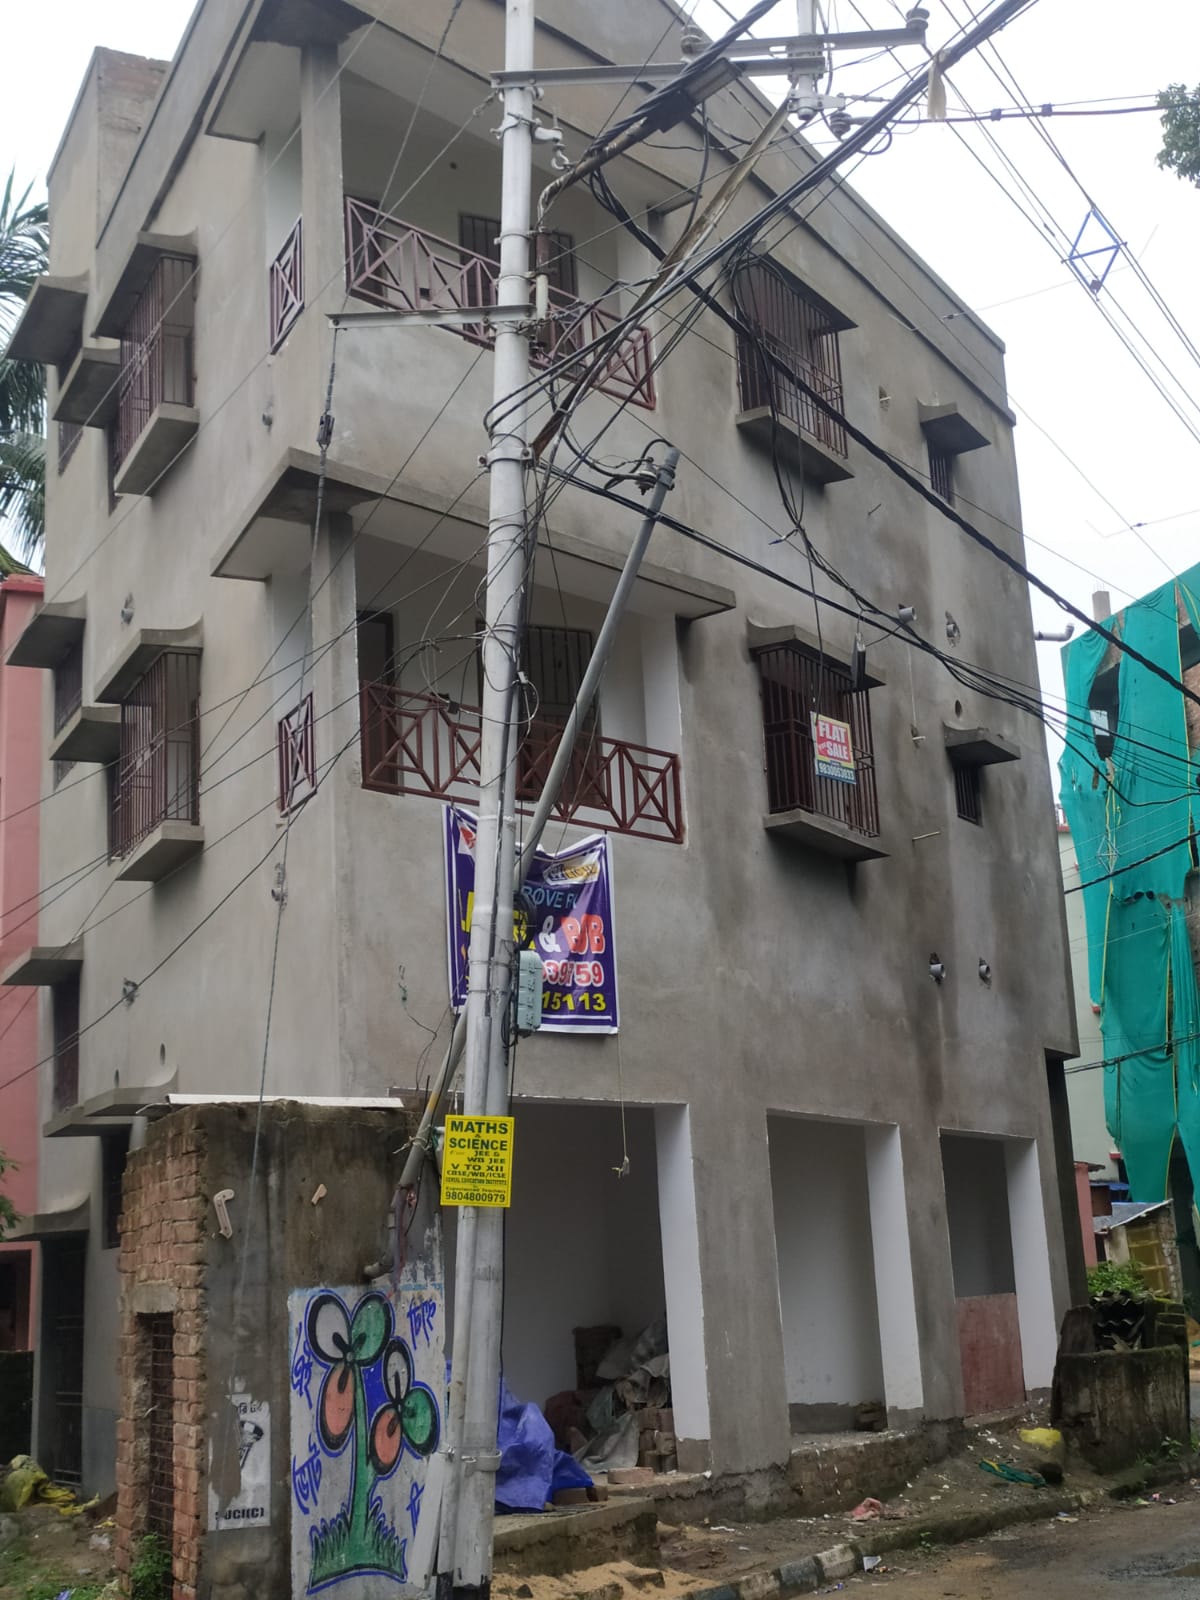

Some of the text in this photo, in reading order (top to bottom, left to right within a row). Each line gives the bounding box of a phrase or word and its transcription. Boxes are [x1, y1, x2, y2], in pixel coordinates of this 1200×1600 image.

[819, 721, 846, 743] FLAT
[826, 742, 849, 760] SALE
[521, 885, 563, 909] ROVE
[451, 1121, 508, 1134] MATHS
[449, 1137, 508, 1151] SCIENCE
[445, 1191, 506, 1203] 9804800979
[214, 1507, 265, 1522] UCI(C)
